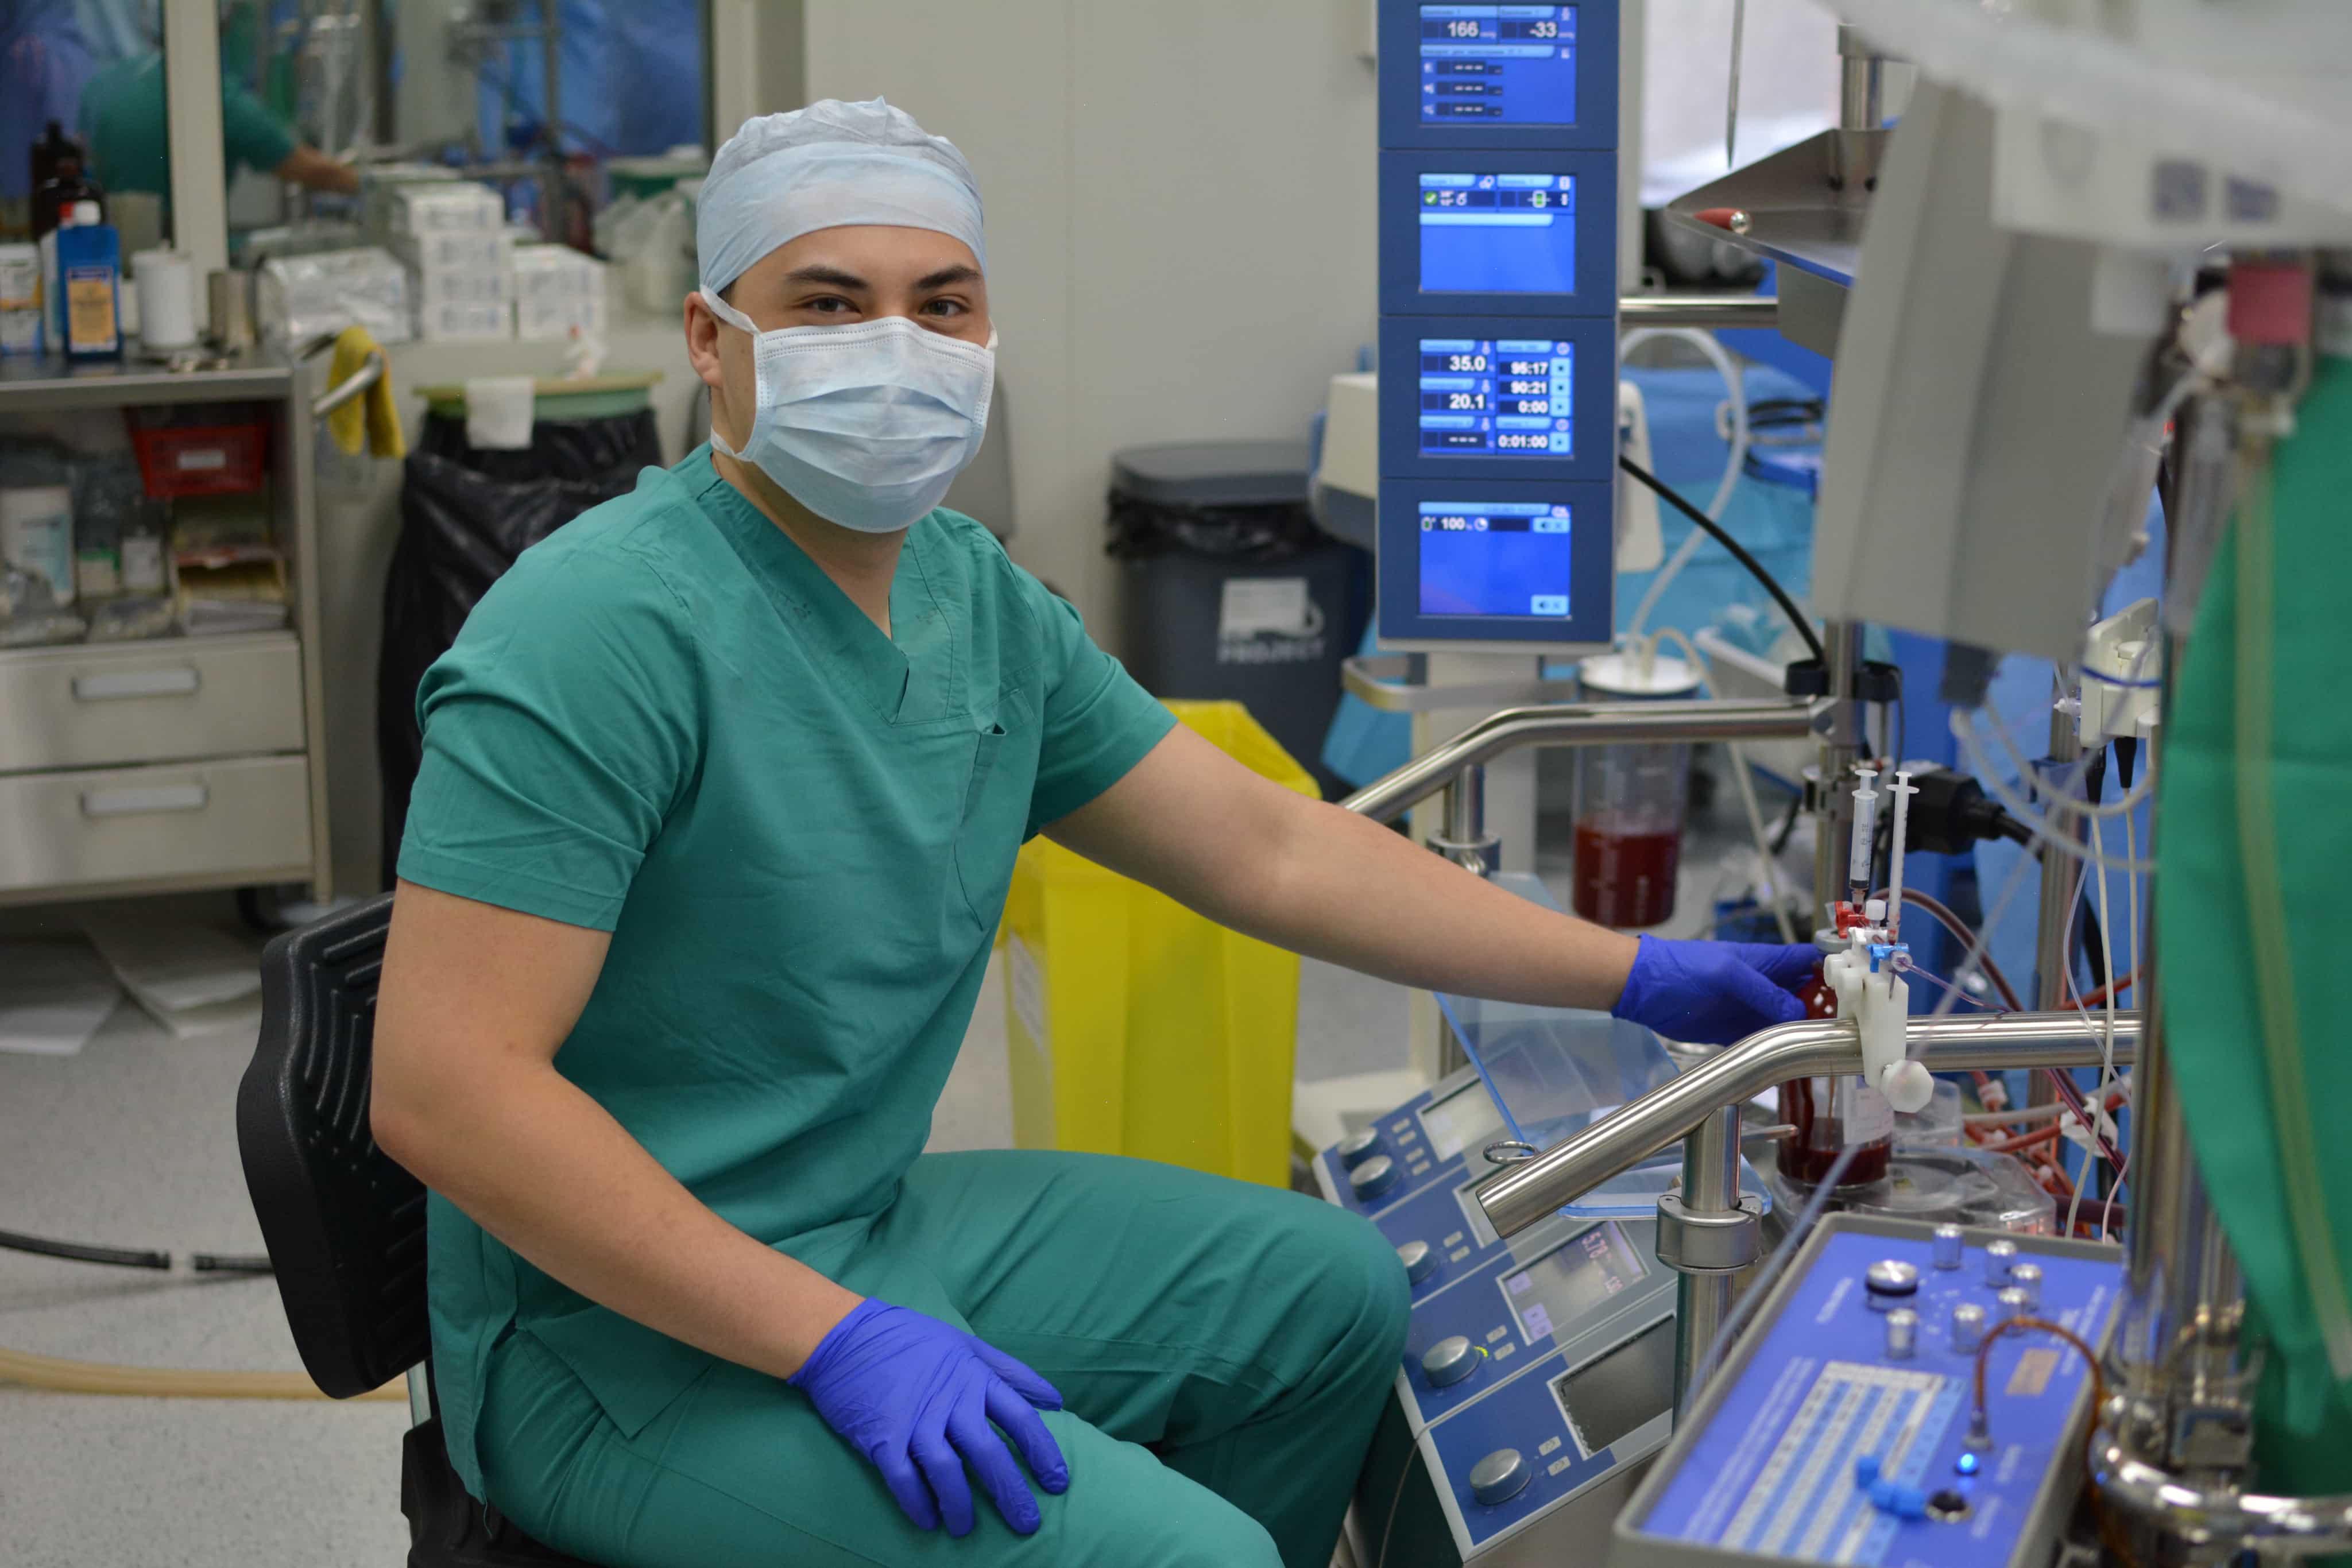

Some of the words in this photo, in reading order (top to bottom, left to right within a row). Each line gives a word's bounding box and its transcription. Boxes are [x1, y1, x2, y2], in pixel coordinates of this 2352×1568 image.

[1448, 21, 1479, 37] 166
[1449, 355, 1486, 371] 35.0
[1449, 393, 1484, 409] 20.1
[1518, 400, 1548, 413] 0:00
[1498, 435, 1548, 448] 0:01:00
[1441, 516, 1465, 530] 100
